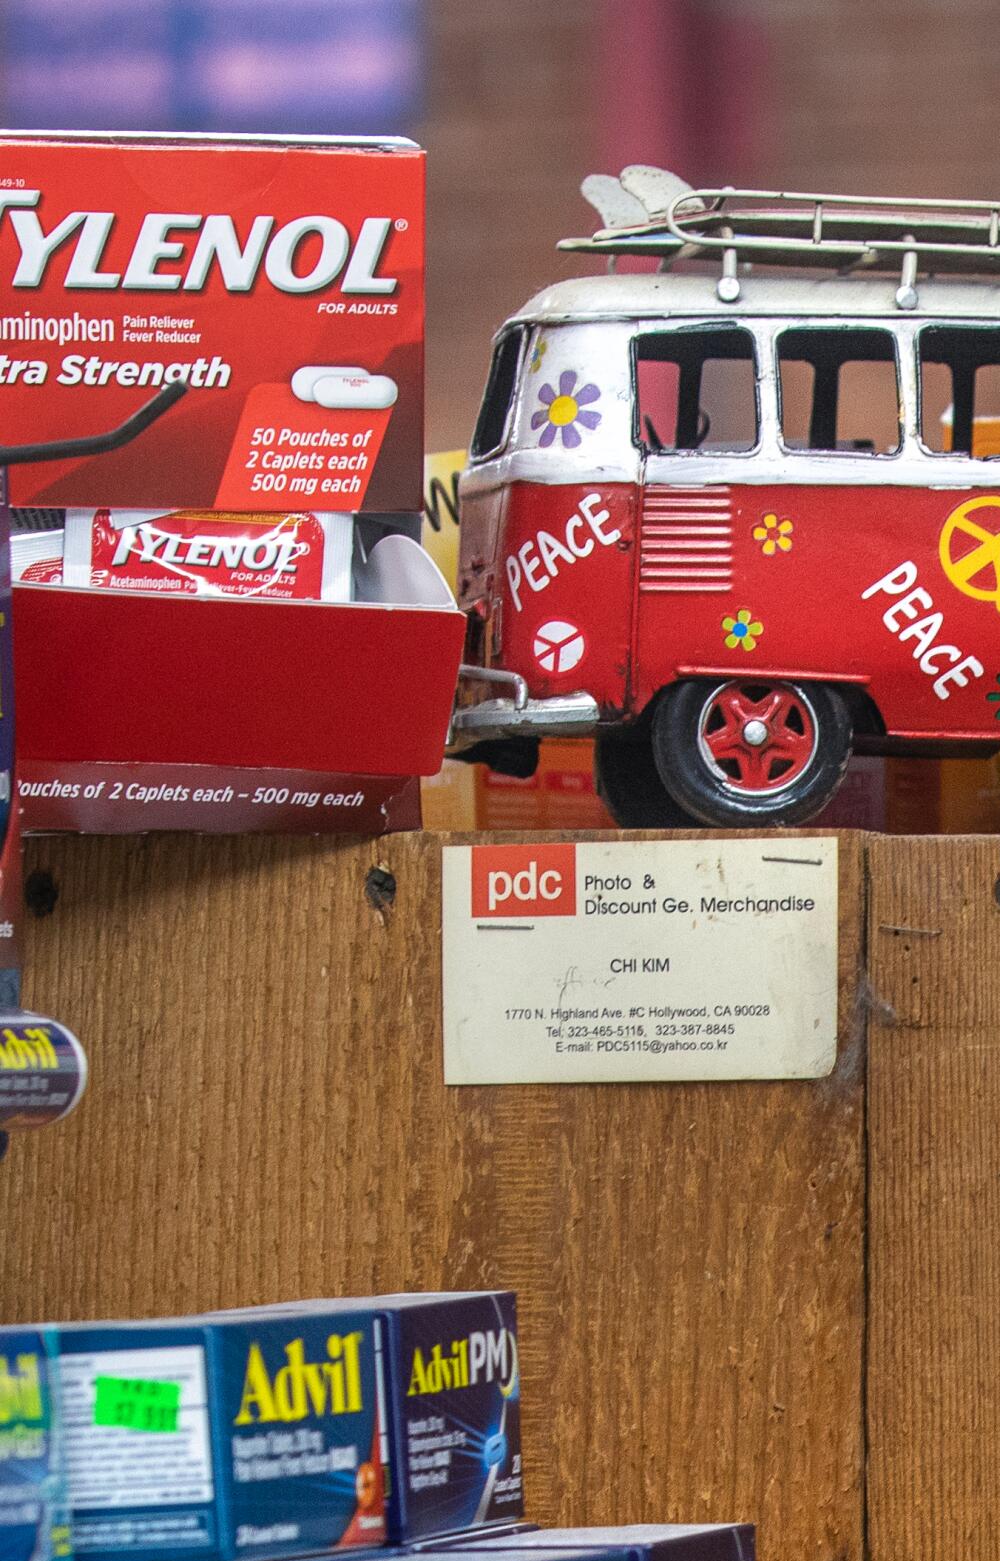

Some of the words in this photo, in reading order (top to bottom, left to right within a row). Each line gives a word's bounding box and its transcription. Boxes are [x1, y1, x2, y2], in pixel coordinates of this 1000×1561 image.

[318, 303, 345, 314] FOR
[348, 303, 398, 315] ADULTS
[0, 311, 114, 346] minophen
[123, 315, 147, 328] Pain
[150, 317, 194, 329] Reliever
[123, 330, 153, 342] Fever
[156, 331, 201, 343] Reducer
[57, 355, 231, 390] Strength
[250, 428, 275, 446] 50
[278, 428, 349, 447] Pouches
[352, 429, 373, 448] of
[245, 451, 259, 469] 2
[261, 452, 324, 471] Caplets
[327, 452, 369, 470] each
[250, 474, 287, 492] 500
[289, 478, 317, 495] mg
[321, 475, 361, 493] each
[112, 527, 298, 573] TYLENOL
[505, 492, 622, 612] PEACE
[110, 575, 181, 590] Acetaminophen
[230, 571, 253, 582] FOR
[255, 573, 296, 585] ADLTS
[861, 560, 984, 700] PEACE
[17, 780, 81, 798] ouches
[84, 782, 106, 799] of
[109, 782, 123, 799] 2
[126, 783, 190, 803] Caplets
[193, 784, 233, 802] each
[251, 787, 289, 804] 500
[291, 790, 320, 808] mg
[323, 790, 364, 806] each
[488, 862, 563, 910] pdc
[584, 875, 631, 891] Photo
[642, 874, 656, 889] &
[584, 898, 657, 915] Discount
[662, 897, 695, 914] Ge.
[700, 895, 815, 914] Merchandise
[610, 958, 638, 973] CHI
[641, 958, 670, 973] KIM
[505, 1009, 532, 1020] 1770
[551, 1007, 598, 1021] Highland
[629, 1007, 645, 1018] #C
[648, 1006, 710, 1020] Hollywood,
[714, 1005, 732, 1017] CA
[734, 1005, 770, 1017] 90028
[234, 1331, 363, 1425] Advil
